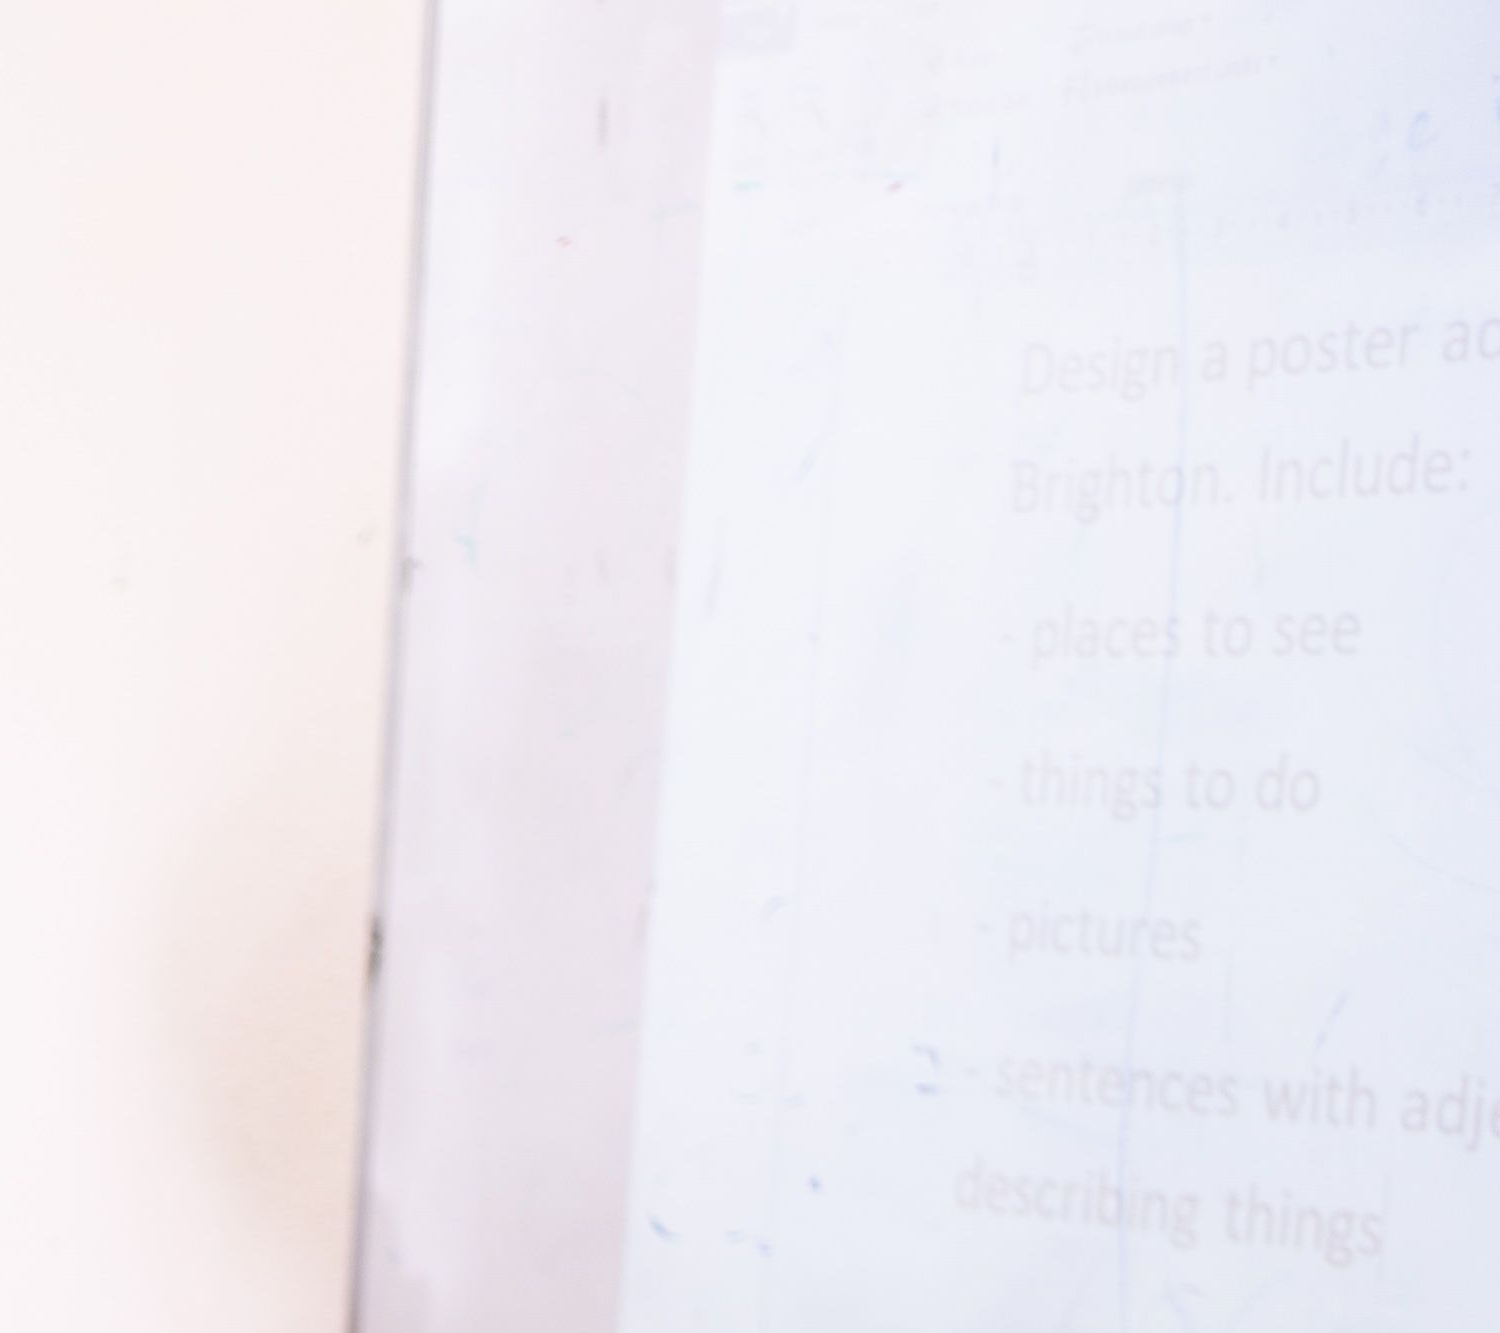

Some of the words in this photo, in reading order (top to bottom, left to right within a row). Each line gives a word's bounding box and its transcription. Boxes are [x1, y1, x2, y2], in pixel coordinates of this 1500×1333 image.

[1017, 333, 1180, 403] Design
[1201, 338, 1228, 383] a
[1246, 317, 1418, 393] poster
[1009, 454, 1233, 525] Brighton.
[1258, 435, 1472, 502] Include:
[1031, 603, 1182, 670] places
[1202, 610, 1252, 660] to
[1272, 611, 1362, 658] see
[1019, 751, 1163, 823] things
[1184, 760, 1236, 811] to
[1254, 752, 1322, 812] do
[1007, 901, 1202, 965] pictures
[996, 1053, 1241, 1118] sentences
[1262, 1068, 1377, 1131] with
[953, 1154, 1201, 1250] describing
[1224, 1181, 1386, 1268] things
